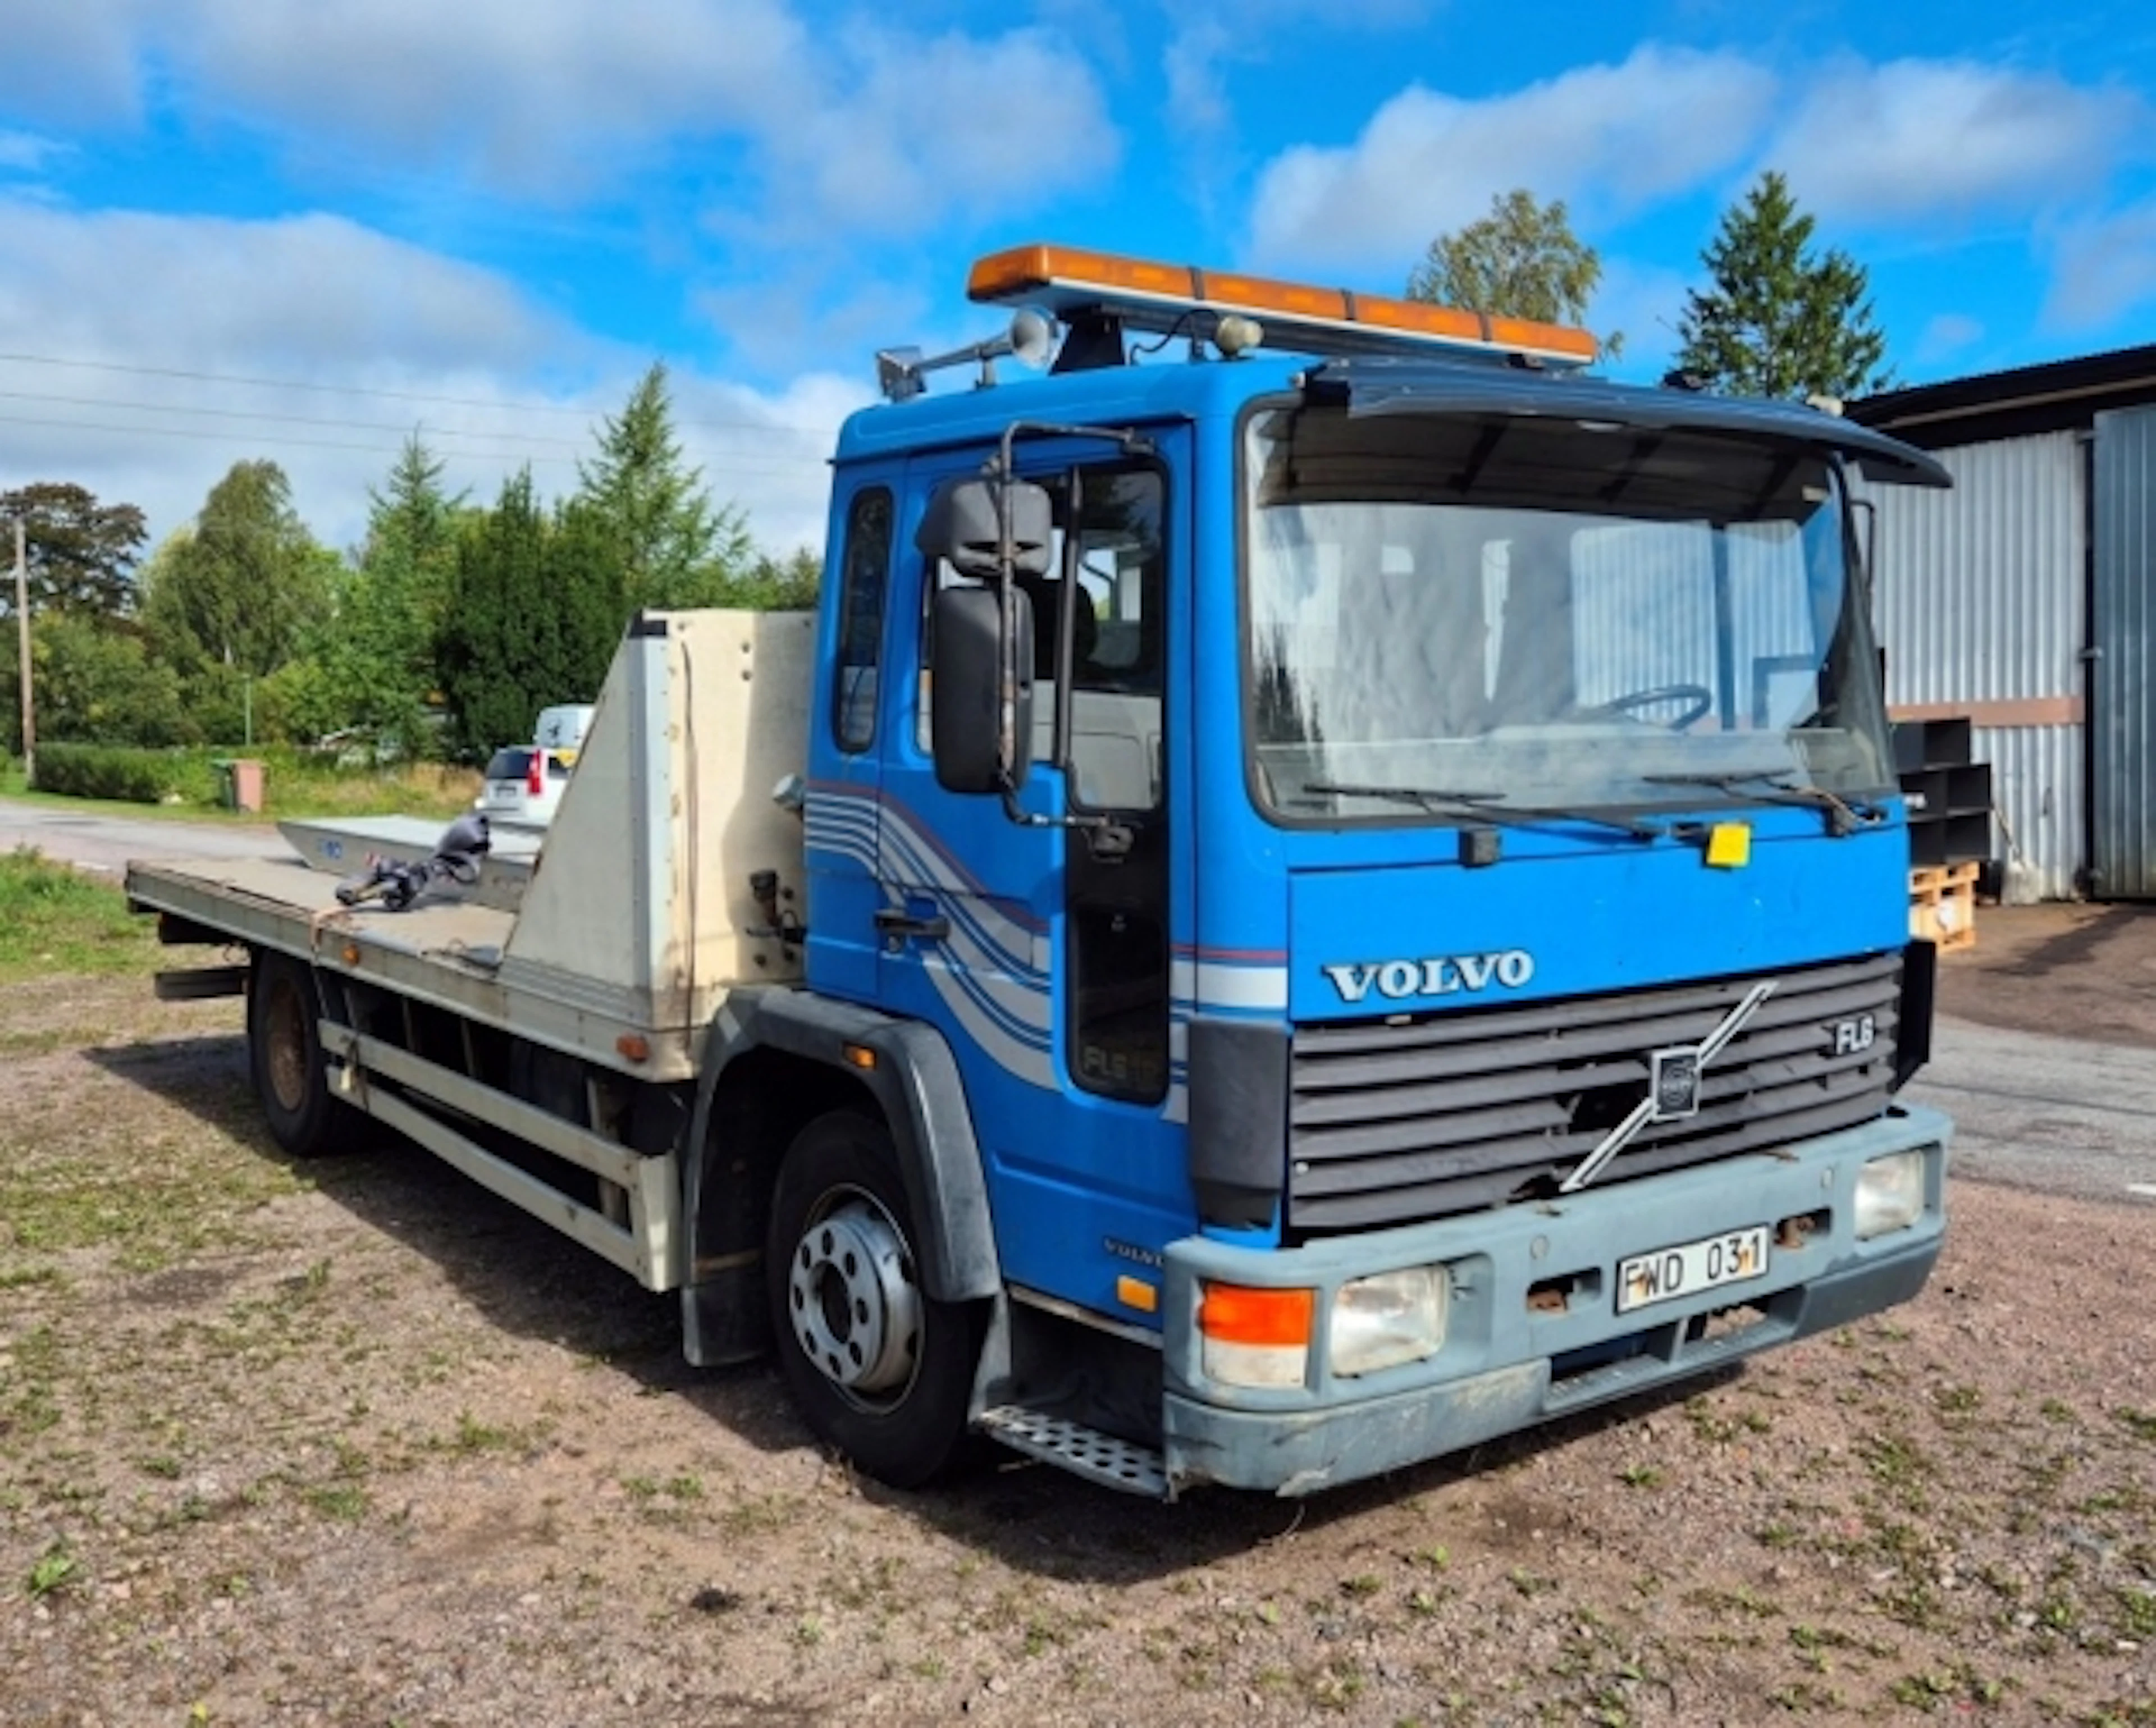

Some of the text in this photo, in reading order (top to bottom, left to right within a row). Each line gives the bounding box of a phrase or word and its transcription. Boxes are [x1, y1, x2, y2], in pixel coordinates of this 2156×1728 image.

[1324, 949, 1534, 1002] VOLVO
[1833, 1016, 1874, 1055] FL6
[1707, 1233, 1760, 1281] 031
